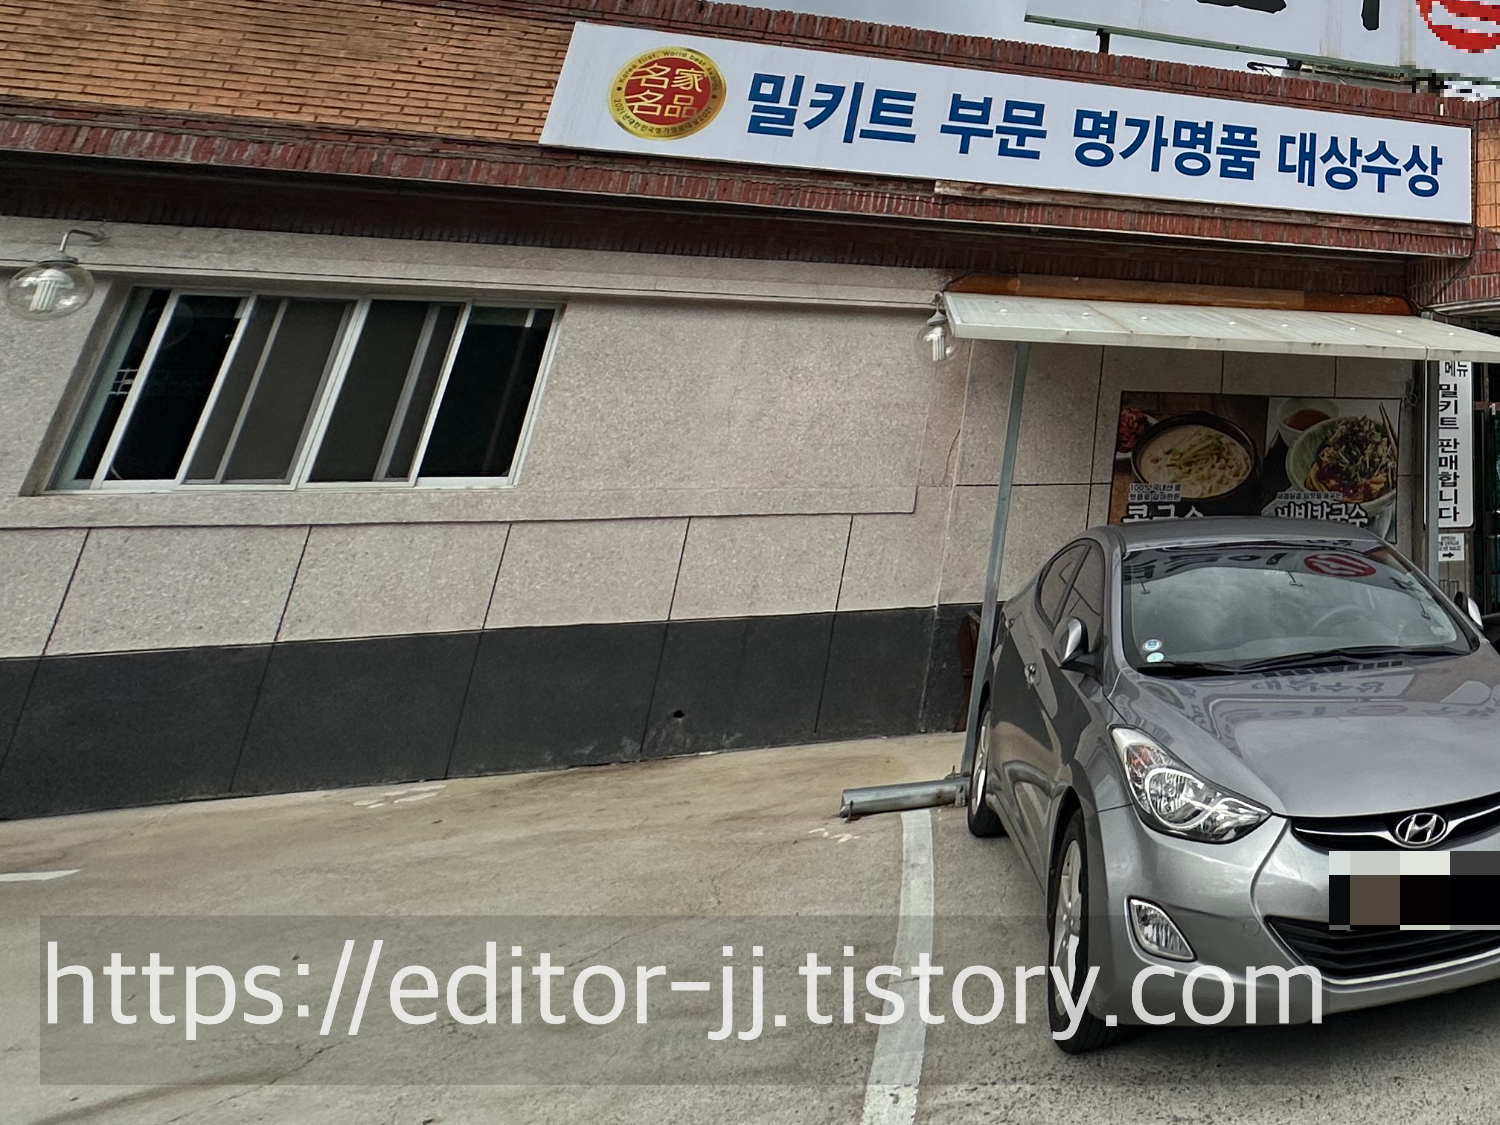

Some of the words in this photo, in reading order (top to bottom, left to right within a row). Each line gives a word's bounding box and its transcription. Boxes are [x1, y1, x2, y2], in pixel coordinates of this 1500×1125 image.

[663, 50, 687, 58] World
[627, 63, 707, 93] 名家
[624, 89, 698, 118] 名品
[747, 73, 916, 144] 밀키트
[940, 93, 1047, 159] 부문
[1073, 109, 1260, 180] 명가명품
[1278, 131, 1442, 197] 대상수상
[1438, 383, 1459, 430] 밀키트
[1438, 438, 1460, 522] 판매합니다
